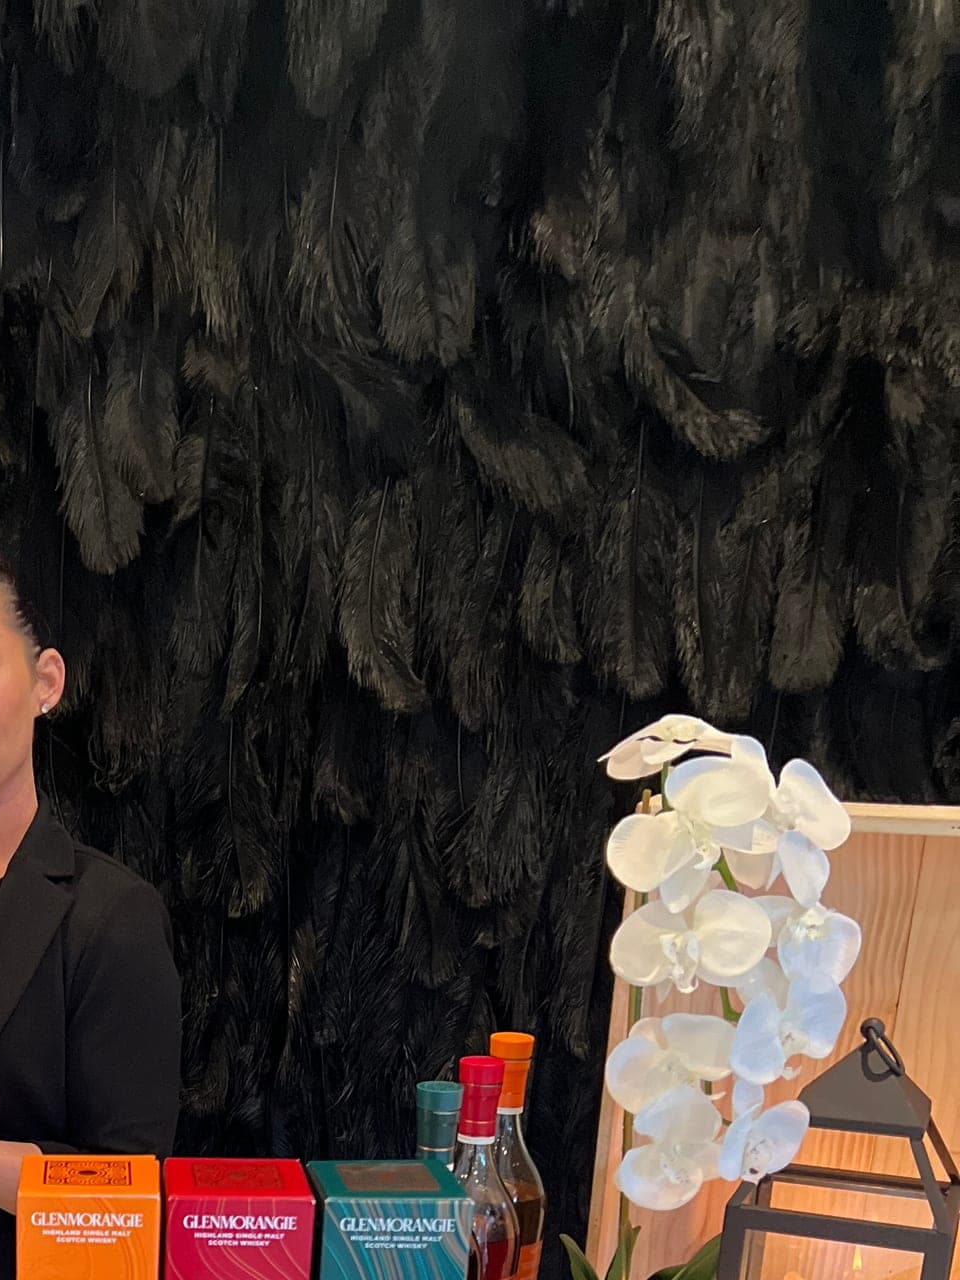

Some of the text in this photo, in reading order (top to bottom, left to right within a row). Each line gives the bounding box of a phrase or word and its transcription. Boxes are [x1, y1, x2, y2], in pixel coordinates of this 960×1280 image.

[30, 1211, 144, 1227] GLENMORANGIE
[182, 1214, 297, 1230] GLENMORANGIE
[339, 1217, 456, 1232] GLENMORANGIE
